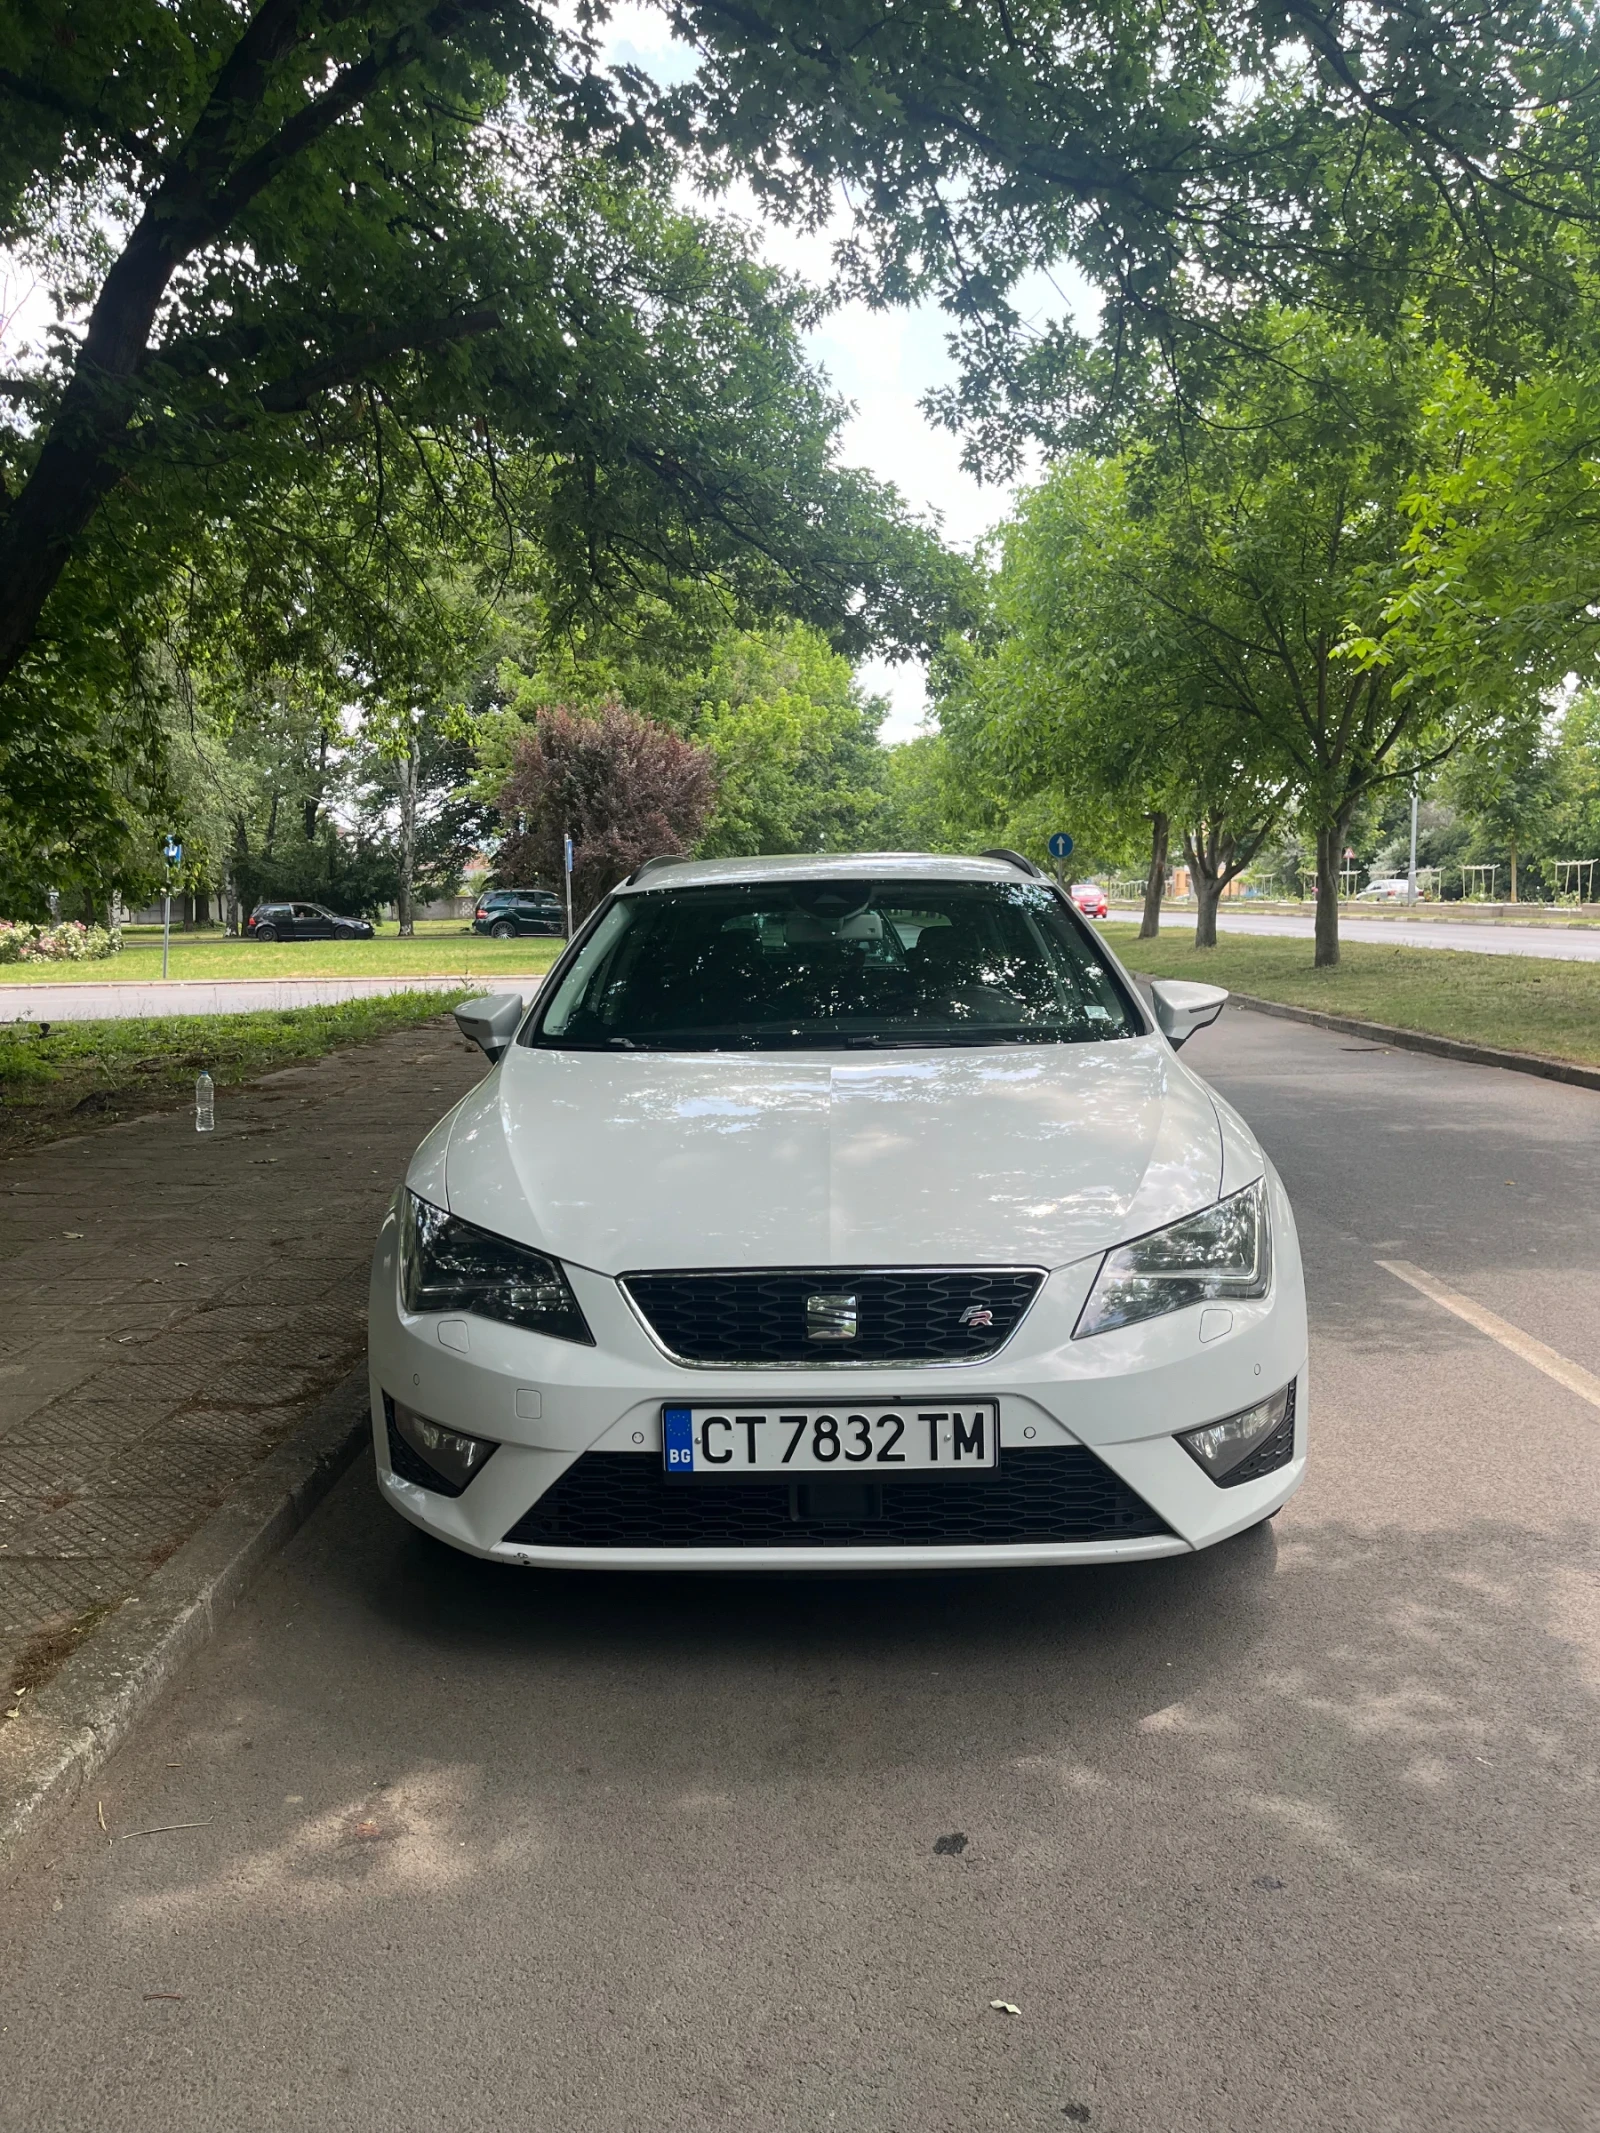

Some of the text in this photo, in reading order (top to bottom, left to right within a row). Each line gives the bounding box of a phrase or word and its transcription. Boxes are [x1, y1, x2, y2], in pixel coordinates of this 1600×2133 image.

[958, 1304, 993, 1326] FR
[701, 1411, 986, 1464] CT 7832 TM
[669, 1449, 691, 1464] BG
